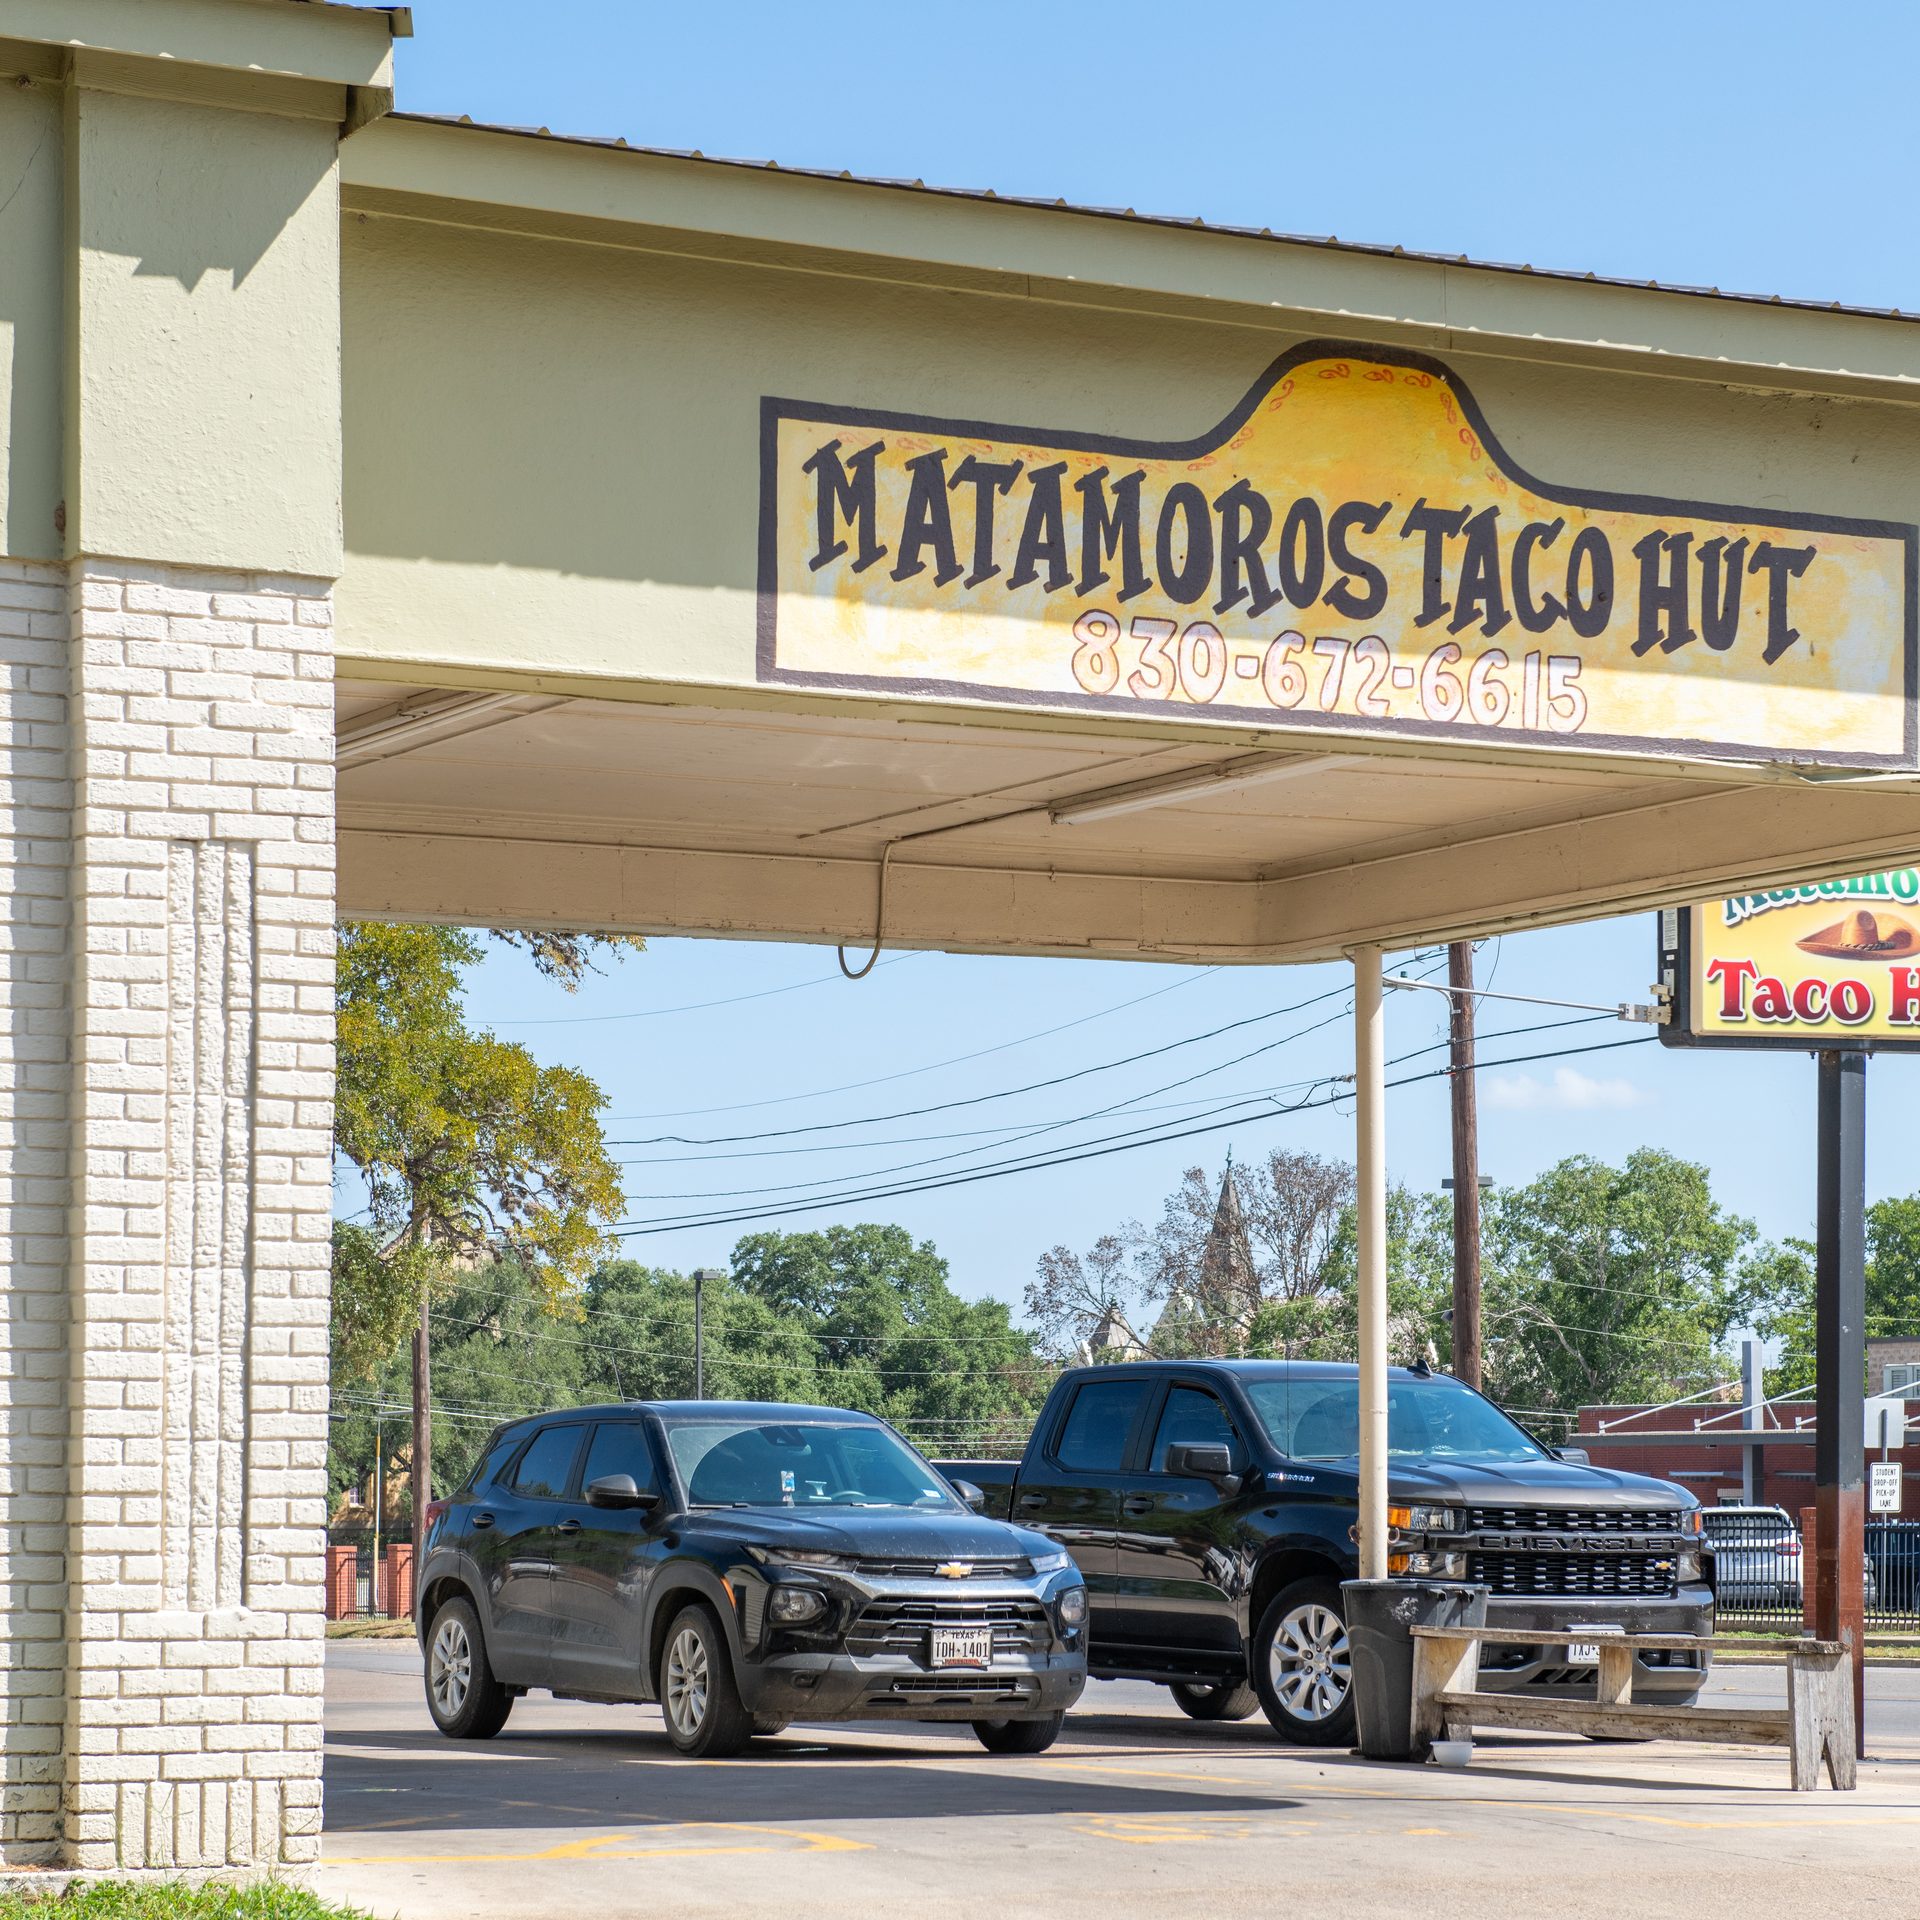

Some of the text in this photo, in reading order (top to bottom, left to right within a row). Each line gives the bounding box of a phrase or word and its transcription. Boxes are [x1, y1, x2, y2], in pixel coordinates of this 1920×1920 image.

[802, 438, 1817, 666] MATAMOROS TACO HUT
[1071, 608, 1588, 735] 830-672-6615
[1706, 959, 1871, 1021] Taco
[1876, 1468, 1896, 1476] STUDENT
[1879, 1499, 1892, 1507] LANE
[1478, 1535, 1682, 1551] CHEVROLET
[951, 1630, 975, 1639] TEXAS
